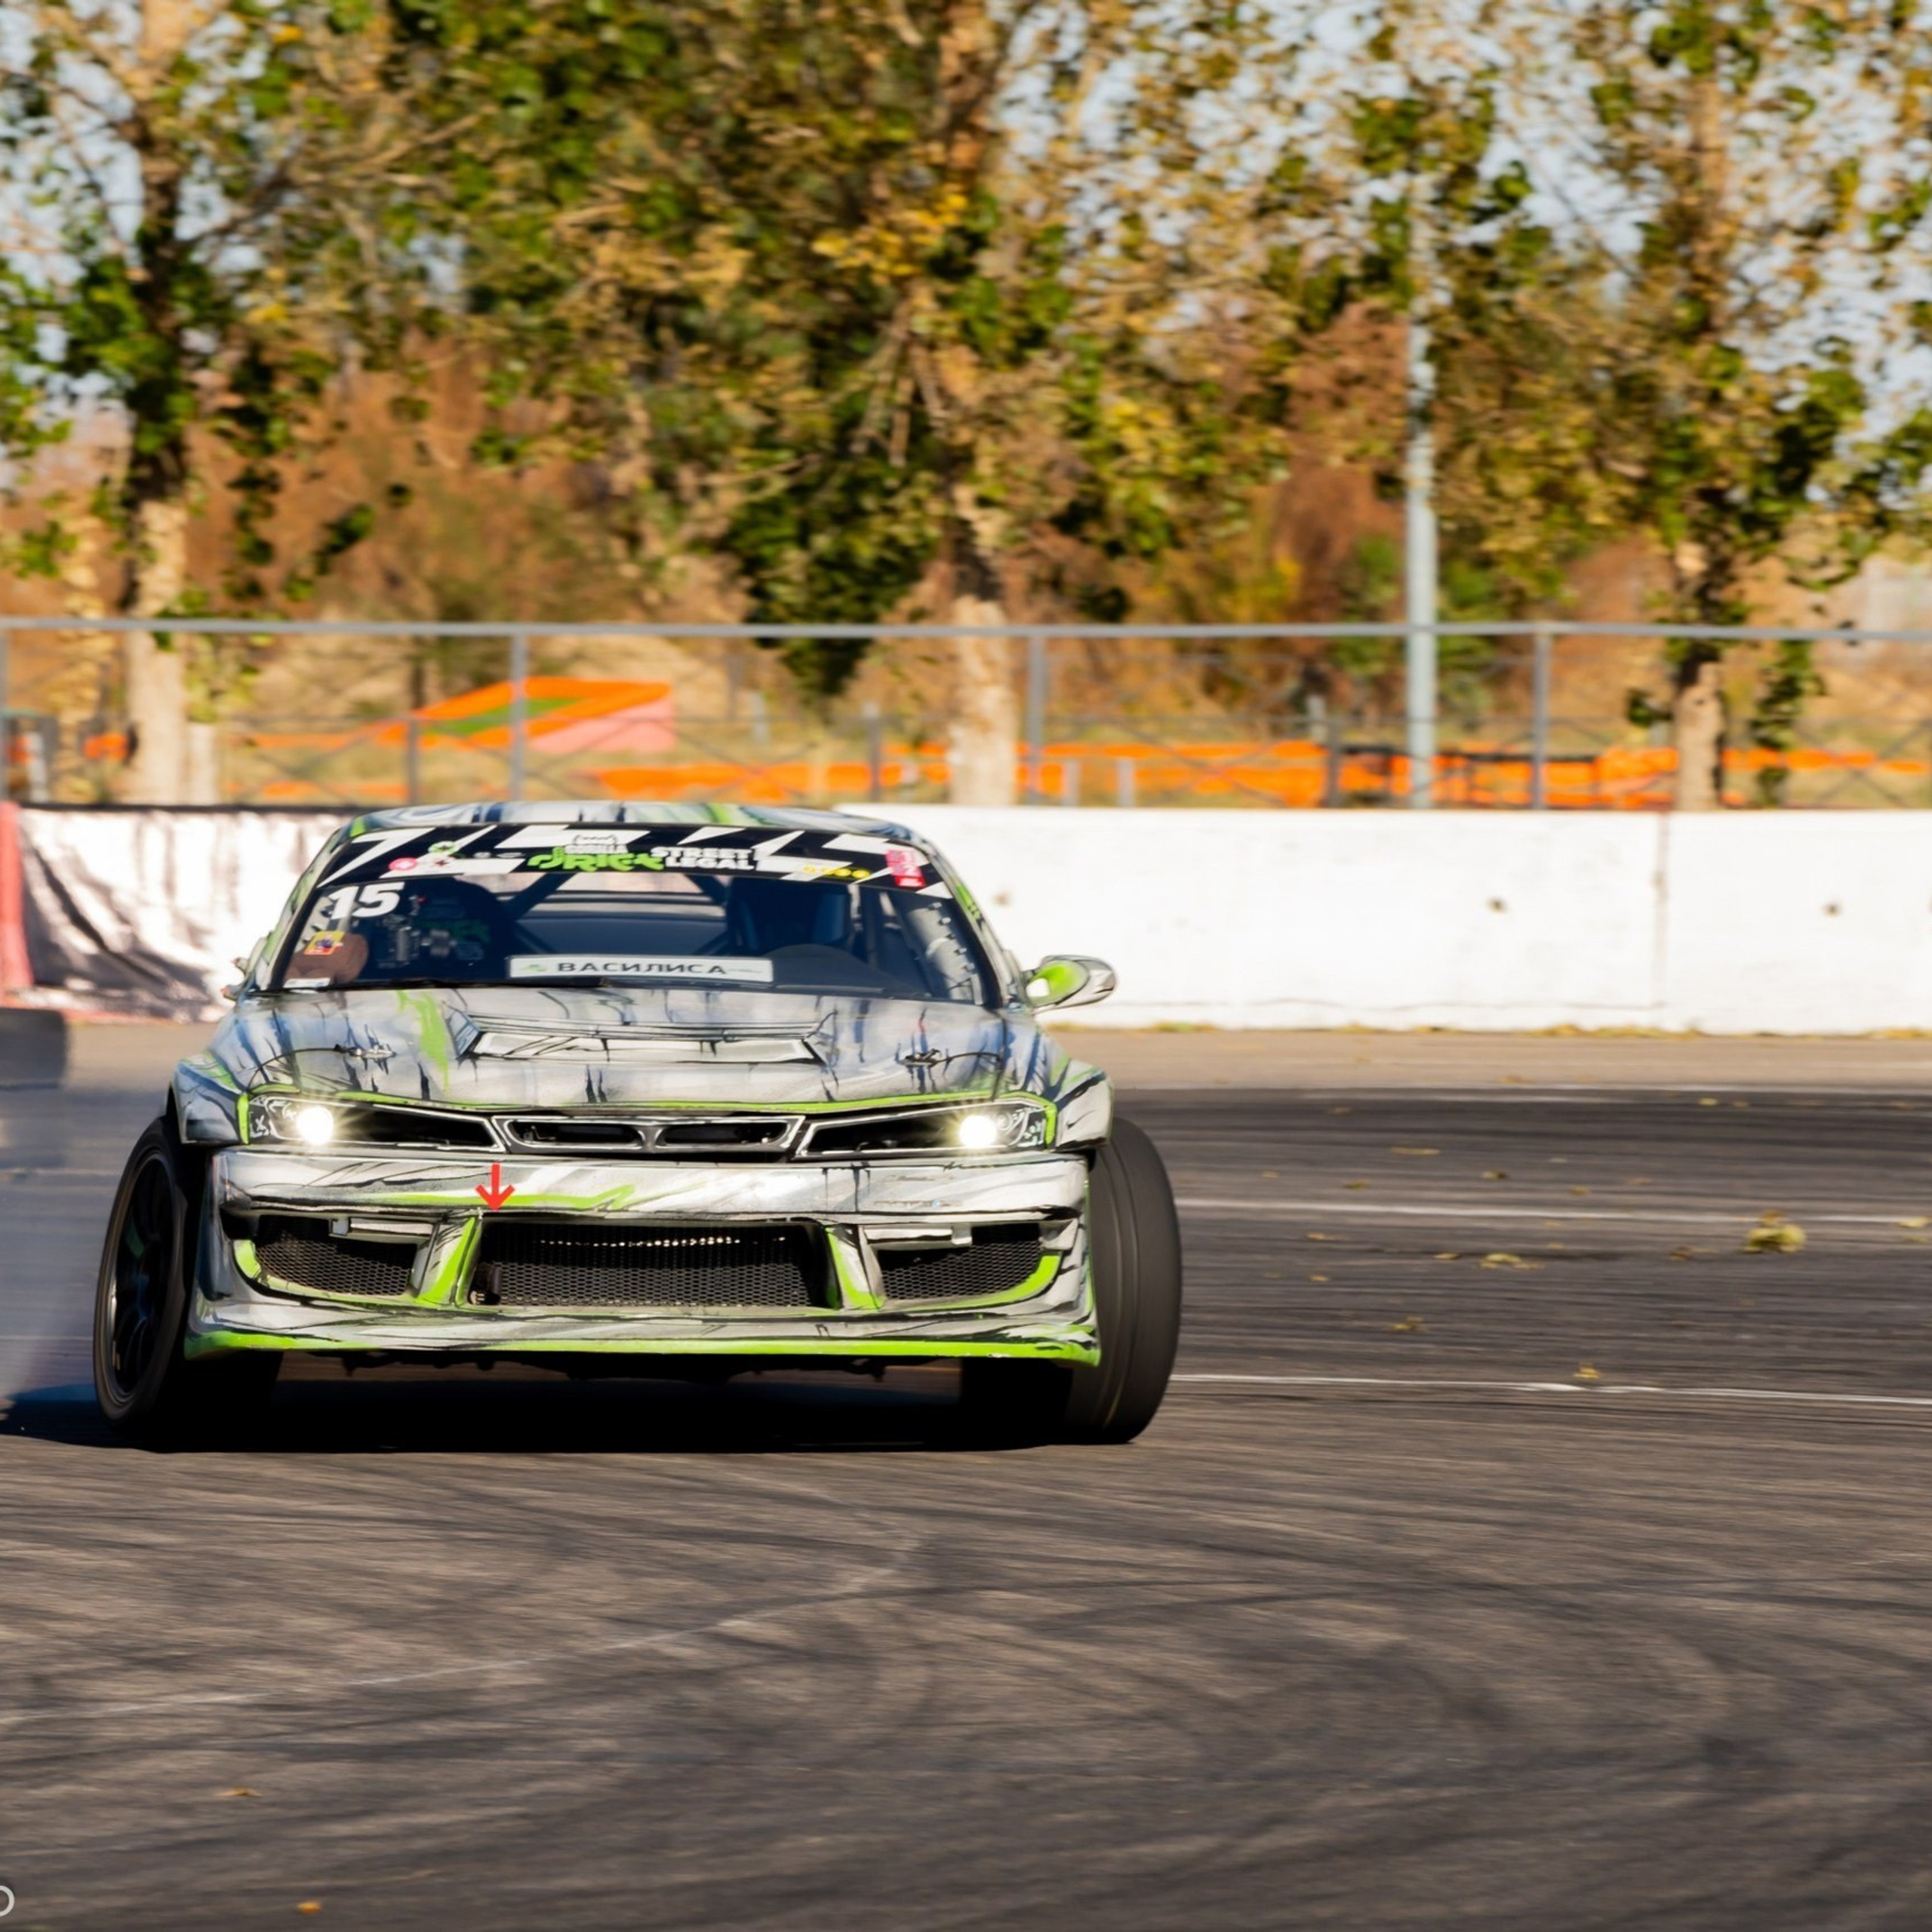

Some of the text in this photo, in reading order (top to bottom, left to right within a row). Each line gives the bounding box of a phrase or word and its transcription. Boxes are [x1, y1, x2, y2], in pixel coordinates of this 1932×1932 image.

[650, 846, 753, 859] STREET
[665, 856, 755, 870] LEGAL
[328, 881, 405, 920] 15
[557, 961, 727, 975] ВАСИЛИСА
